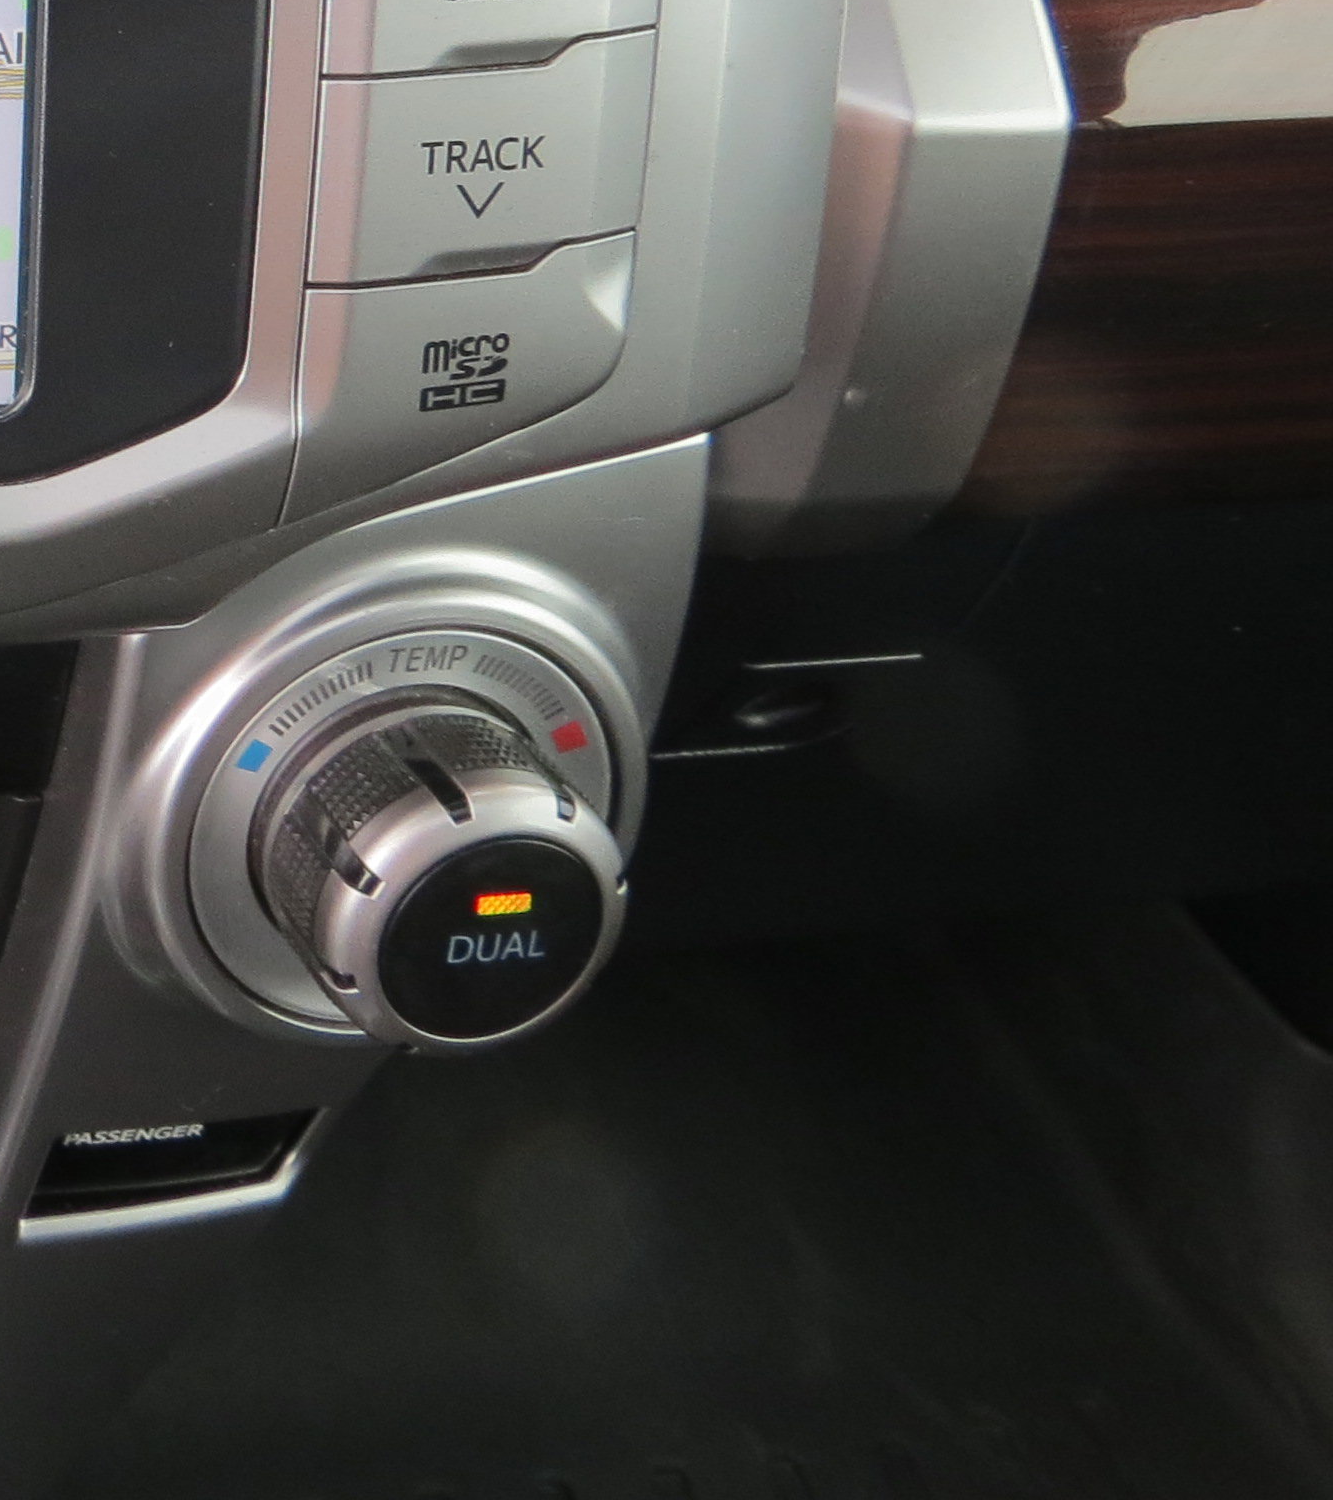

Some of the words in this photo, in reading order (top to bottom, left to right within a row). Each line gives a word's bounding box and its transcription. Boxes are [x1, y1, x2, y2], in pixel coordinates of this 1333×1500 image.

[420, 135, 546, 176] TRACK
[422, 332, 510, 375] micro
[387, 644, 470, 675] TEMP
[446, 929, 546, 965] DUAL
[63, 1122, 205, 1147] PASSENGER
